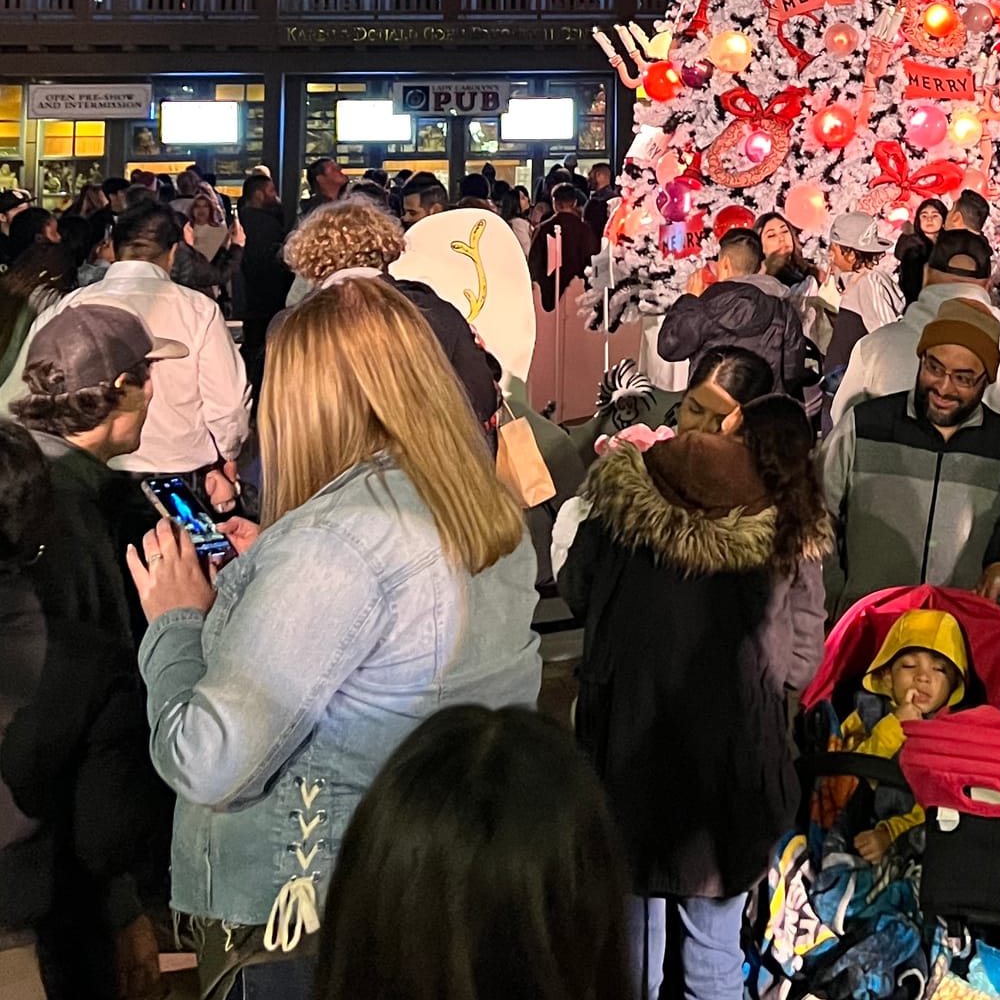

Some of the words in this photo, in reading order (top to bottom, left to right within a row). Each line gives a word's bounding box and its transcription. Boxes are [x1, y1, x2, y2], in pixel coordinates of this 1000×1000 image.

[908, 72, 967, 93] MERRY
[38, 101, 61, 109] AND
[65, 101, 142, 109] INTERMISSION
[45, 93, 75, 102] OPEN
[79, 93, 134, 102] PRE-SHOW
[433, 91, 500, 112] PUB
[662, 231, 704, 254] MERY
